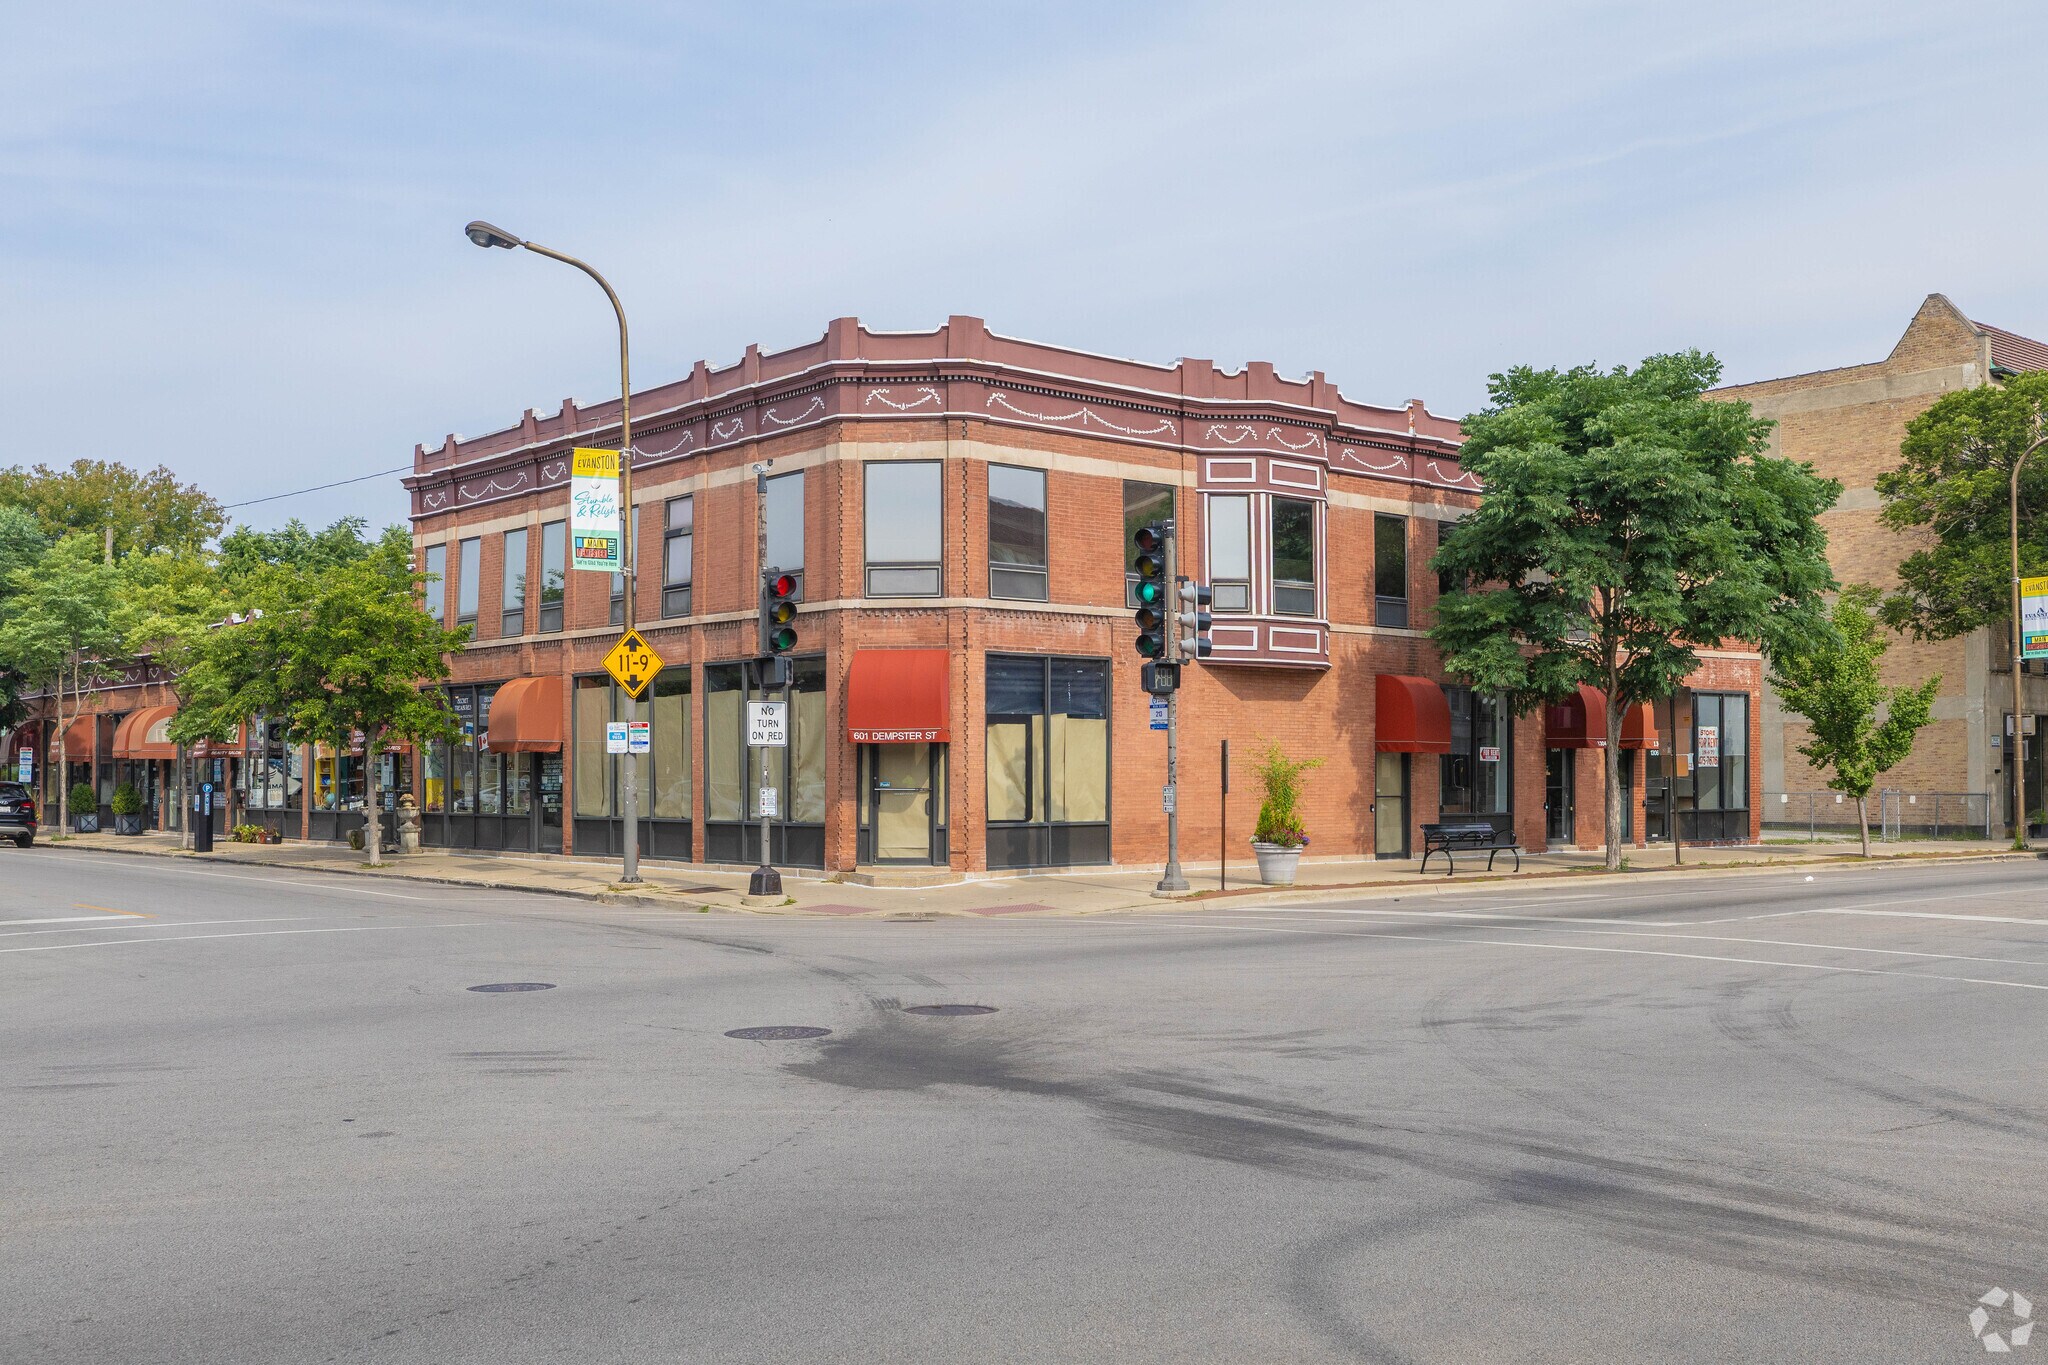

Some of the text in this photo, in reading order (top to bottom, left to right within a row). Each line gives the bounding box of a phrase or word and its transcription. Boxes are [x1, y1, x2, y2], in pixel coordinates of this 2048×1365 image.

[577, 454, 615, 469] EVANSTON
[574, 490, 613, 505] Stumble
[576, 503, 616, 518] & Relish
[587, 539, 604, 548] MAIN
[608, 539, 616, 555] MILE
[761, 706, 775, 716] NO
[757, 719, 779, 728] TURN
[752, 731, 783, 740] ON RED
[853, 731, 937, 740] 601 DEMPSTER ST
[1708, 737, 1718, 748] RENT
